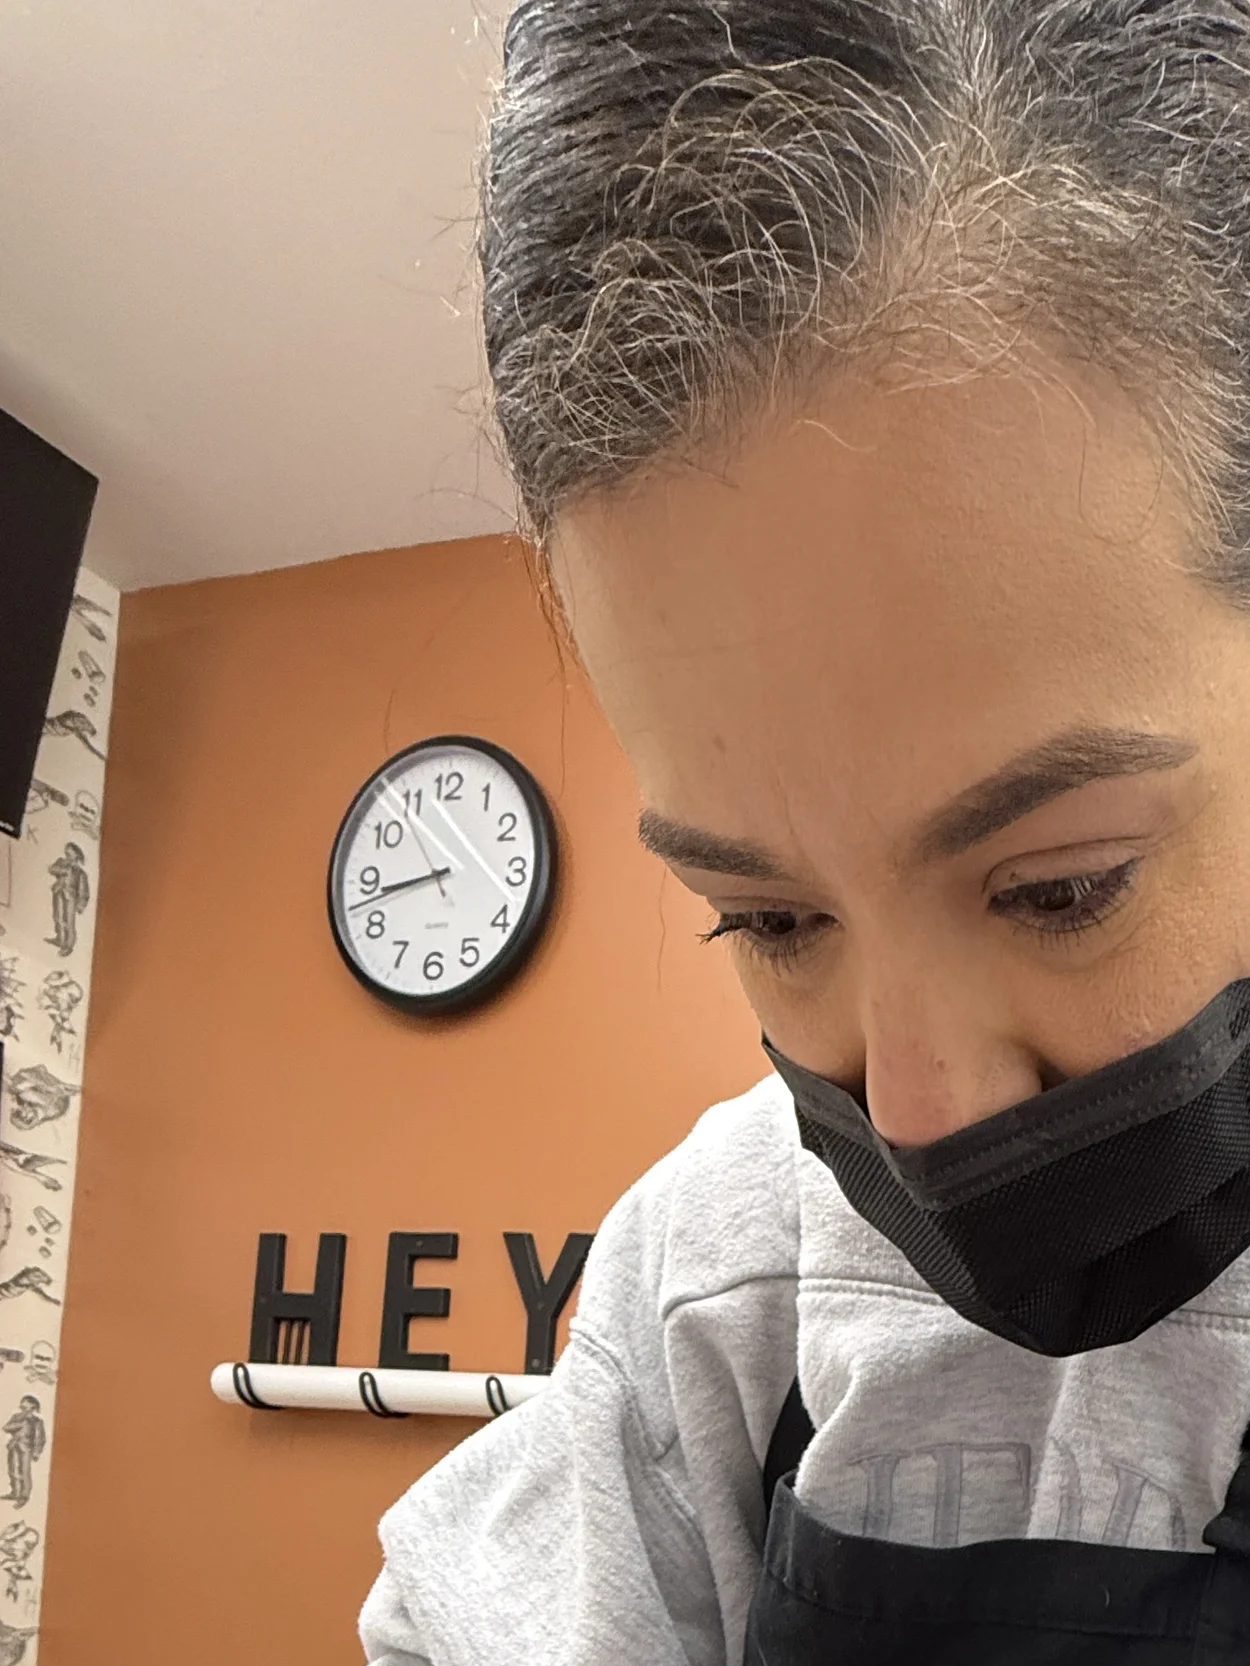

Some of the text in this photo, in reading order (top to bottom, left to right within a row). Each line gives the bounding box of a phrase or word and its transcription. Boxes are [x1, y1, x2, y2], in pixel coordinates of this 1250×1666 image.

[434, 772, 463, 800] 12
[482, 783, 491, 811] 1
[403, 788, 422, 816] 11
[374, 820, 403, 849] 10
[497, 813, 517, 841] 2
[360, 866, 380, 894] 9
[505, 857, 527, 886] 3
[366, 911, 385, 939] 8
[490, 904, 511, 933] 4
[393, 941, 409, 968] 7
[423, 952, 444, 980] 6
[460, 937, 480, 967] 5
[248, 1232, 598, 1376] HEY
